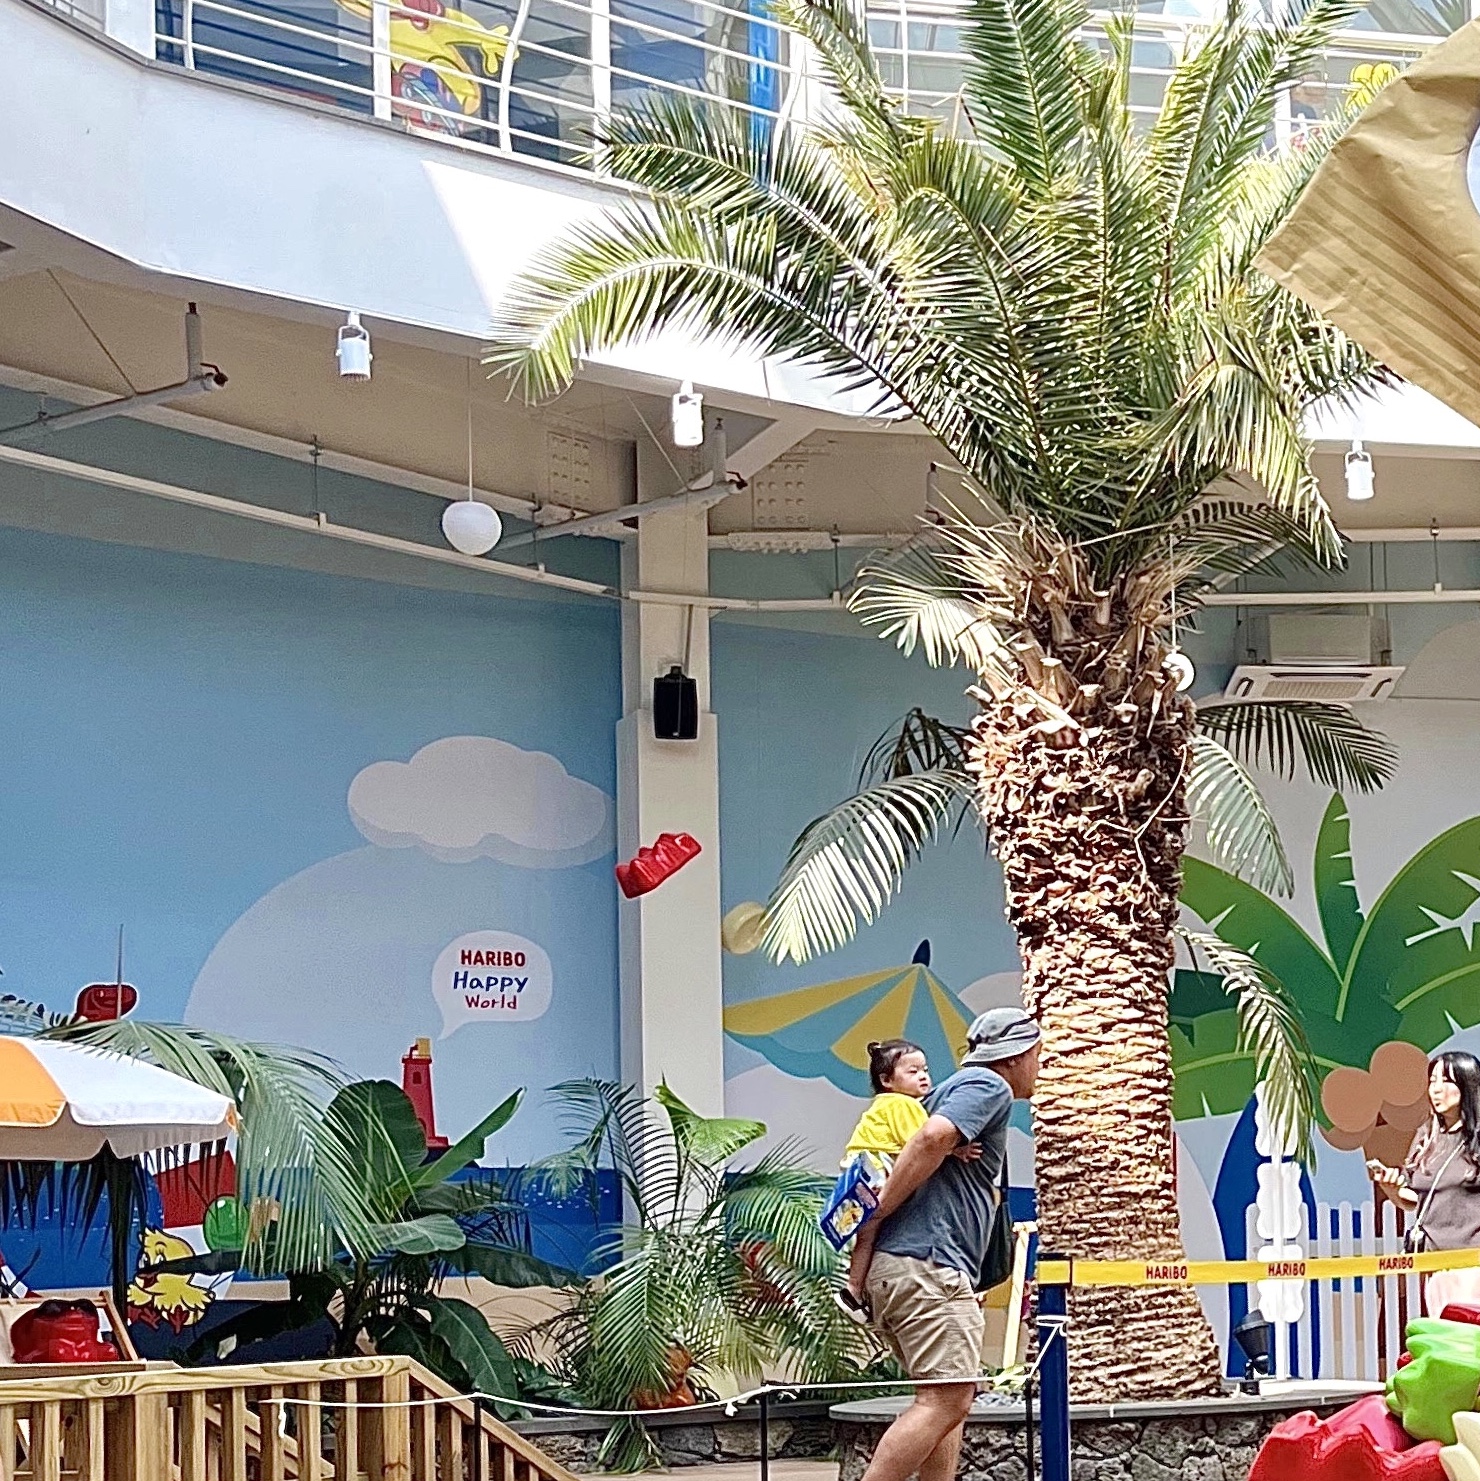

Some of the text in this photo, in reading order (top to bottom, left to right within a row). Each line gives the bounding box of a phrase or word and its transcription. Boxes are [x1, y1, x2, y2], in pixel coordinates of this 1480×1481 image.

[460, 949, 526, 967] HARIBO
[453, 970, 529, 993] Happy
[464, 994, 517, 1010] World
[1145, 1264, 1188, 1281] HARIBO
[1267, 1262, 1307, 1278] HARIBO
[1378, 1255, 1415, 1271] HARIBO
